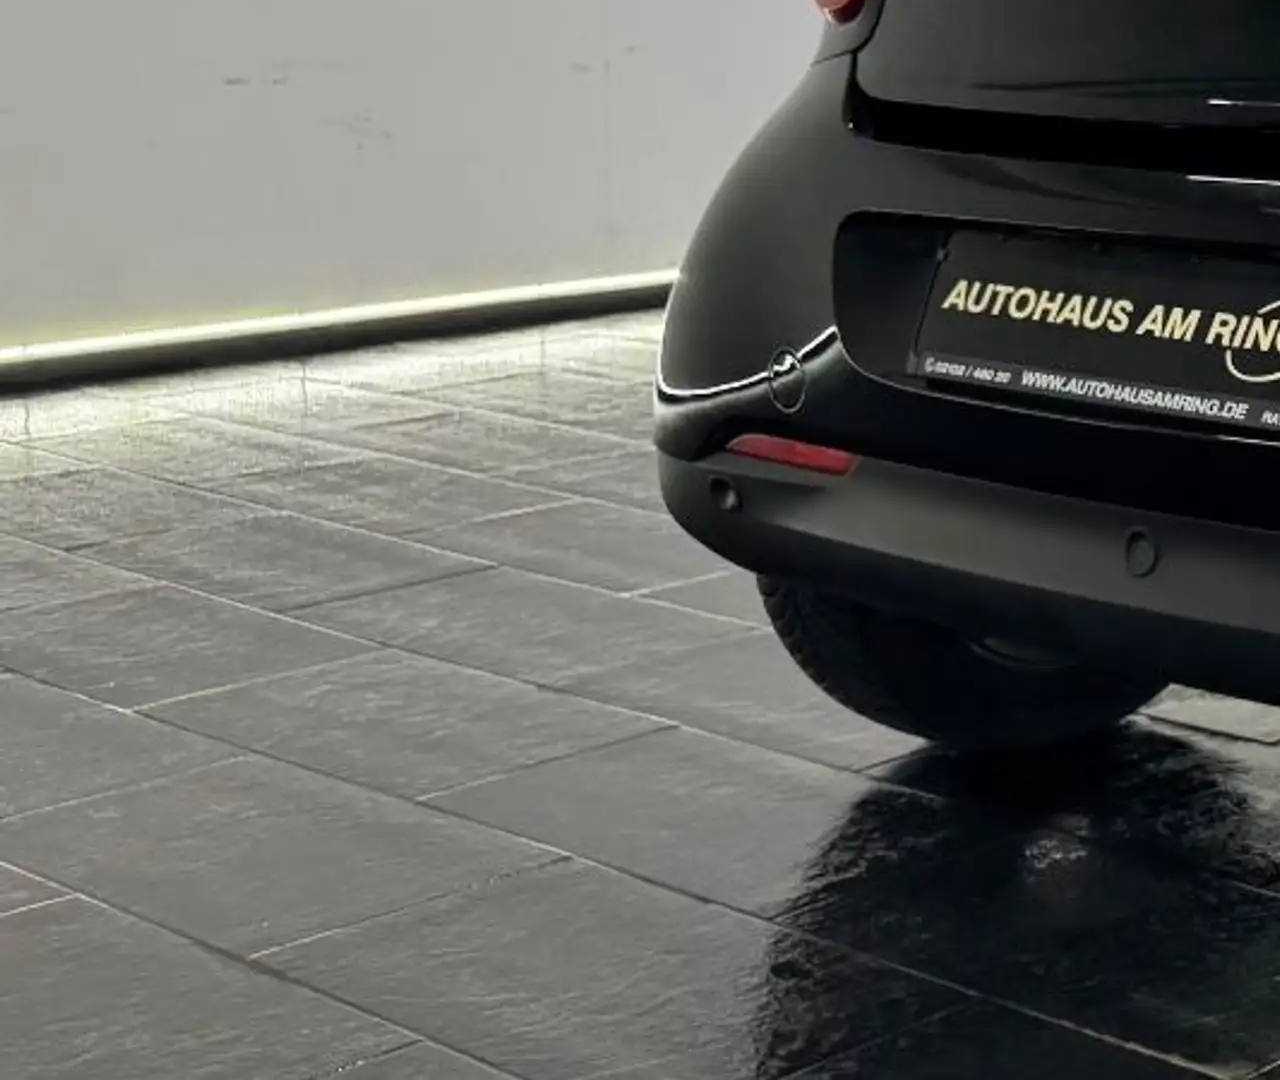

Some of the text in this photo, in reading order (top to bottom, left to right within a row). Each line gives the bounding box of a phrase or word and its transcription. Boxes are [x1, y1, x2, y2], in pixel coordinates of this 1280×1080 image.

[941, 279, 1134, 333] AUTOHAUS
[1136, 304, 1202, 342] AM
[1021, 369, 1250, 421] WWW.AUTOHAUSAMRING.DE
